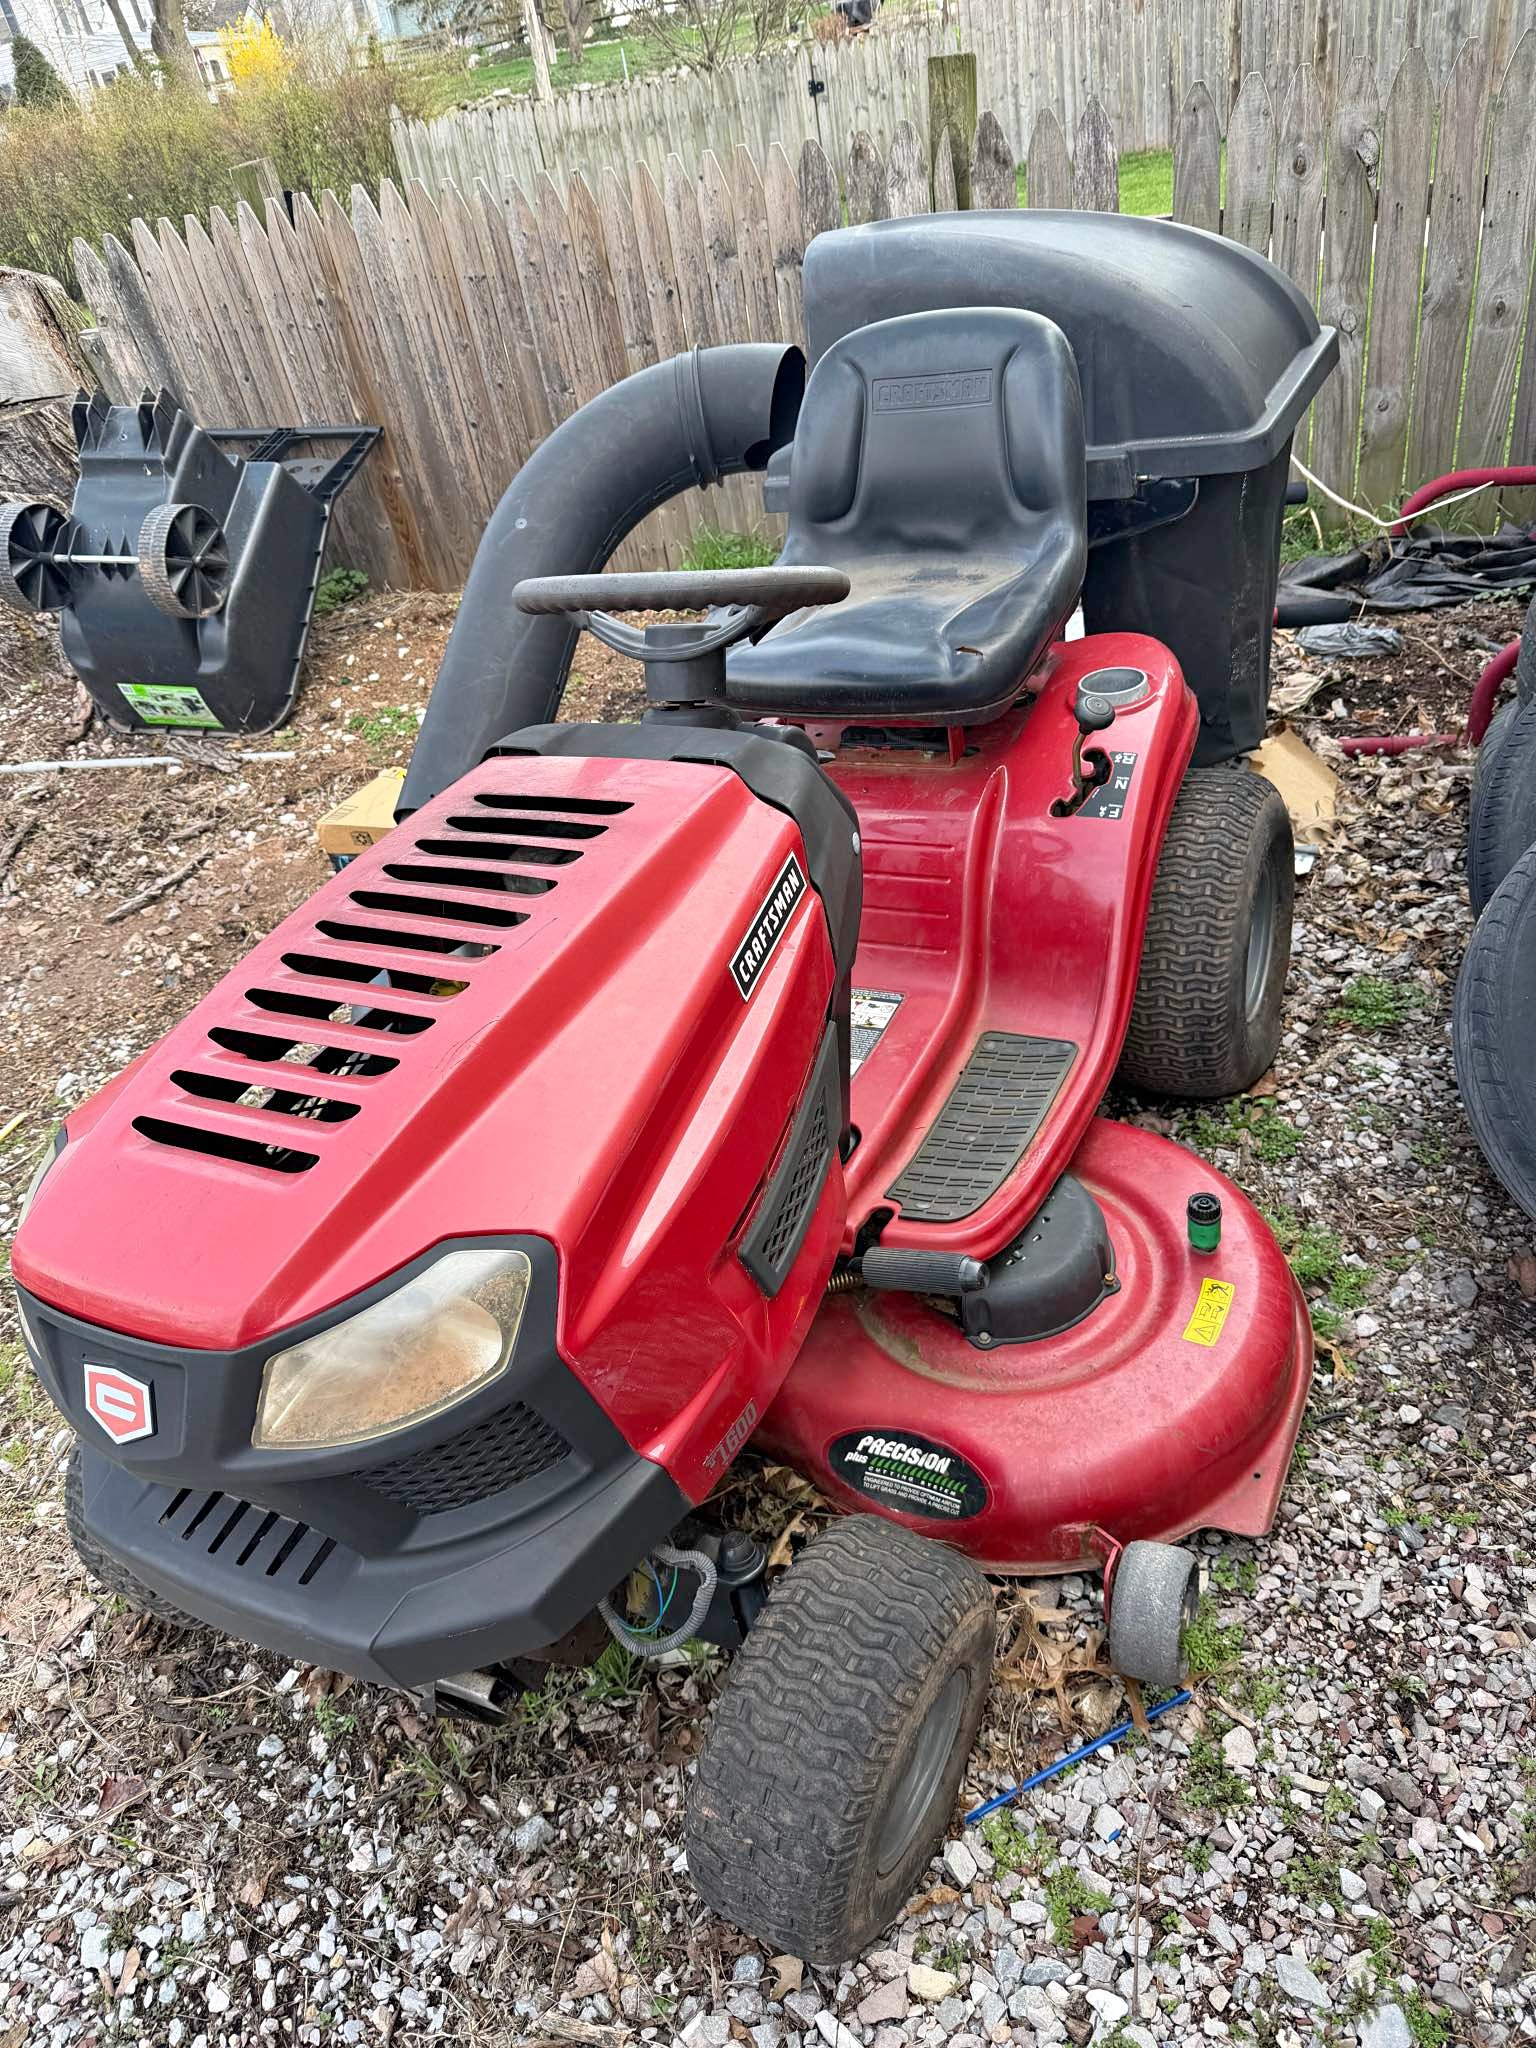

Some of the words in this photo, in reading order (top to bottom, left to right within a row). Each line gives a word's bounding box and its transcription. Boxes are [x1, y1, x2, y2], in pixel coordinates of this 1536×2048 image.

[878, 376, 989, 406] CRAFTSMAN
[1114, 779, 1128, 790] N
[1108, 807, 1120, 818] F
[738, 868, 801, 983] CRAFTSMAN
[844, 1451, 869, 1464] plus
[856, 1435, 952, 1474] PRECISION
[868, 1466, 914, 1482] CUTTING
[920, 1480, 956, 1496] SYSTEM
